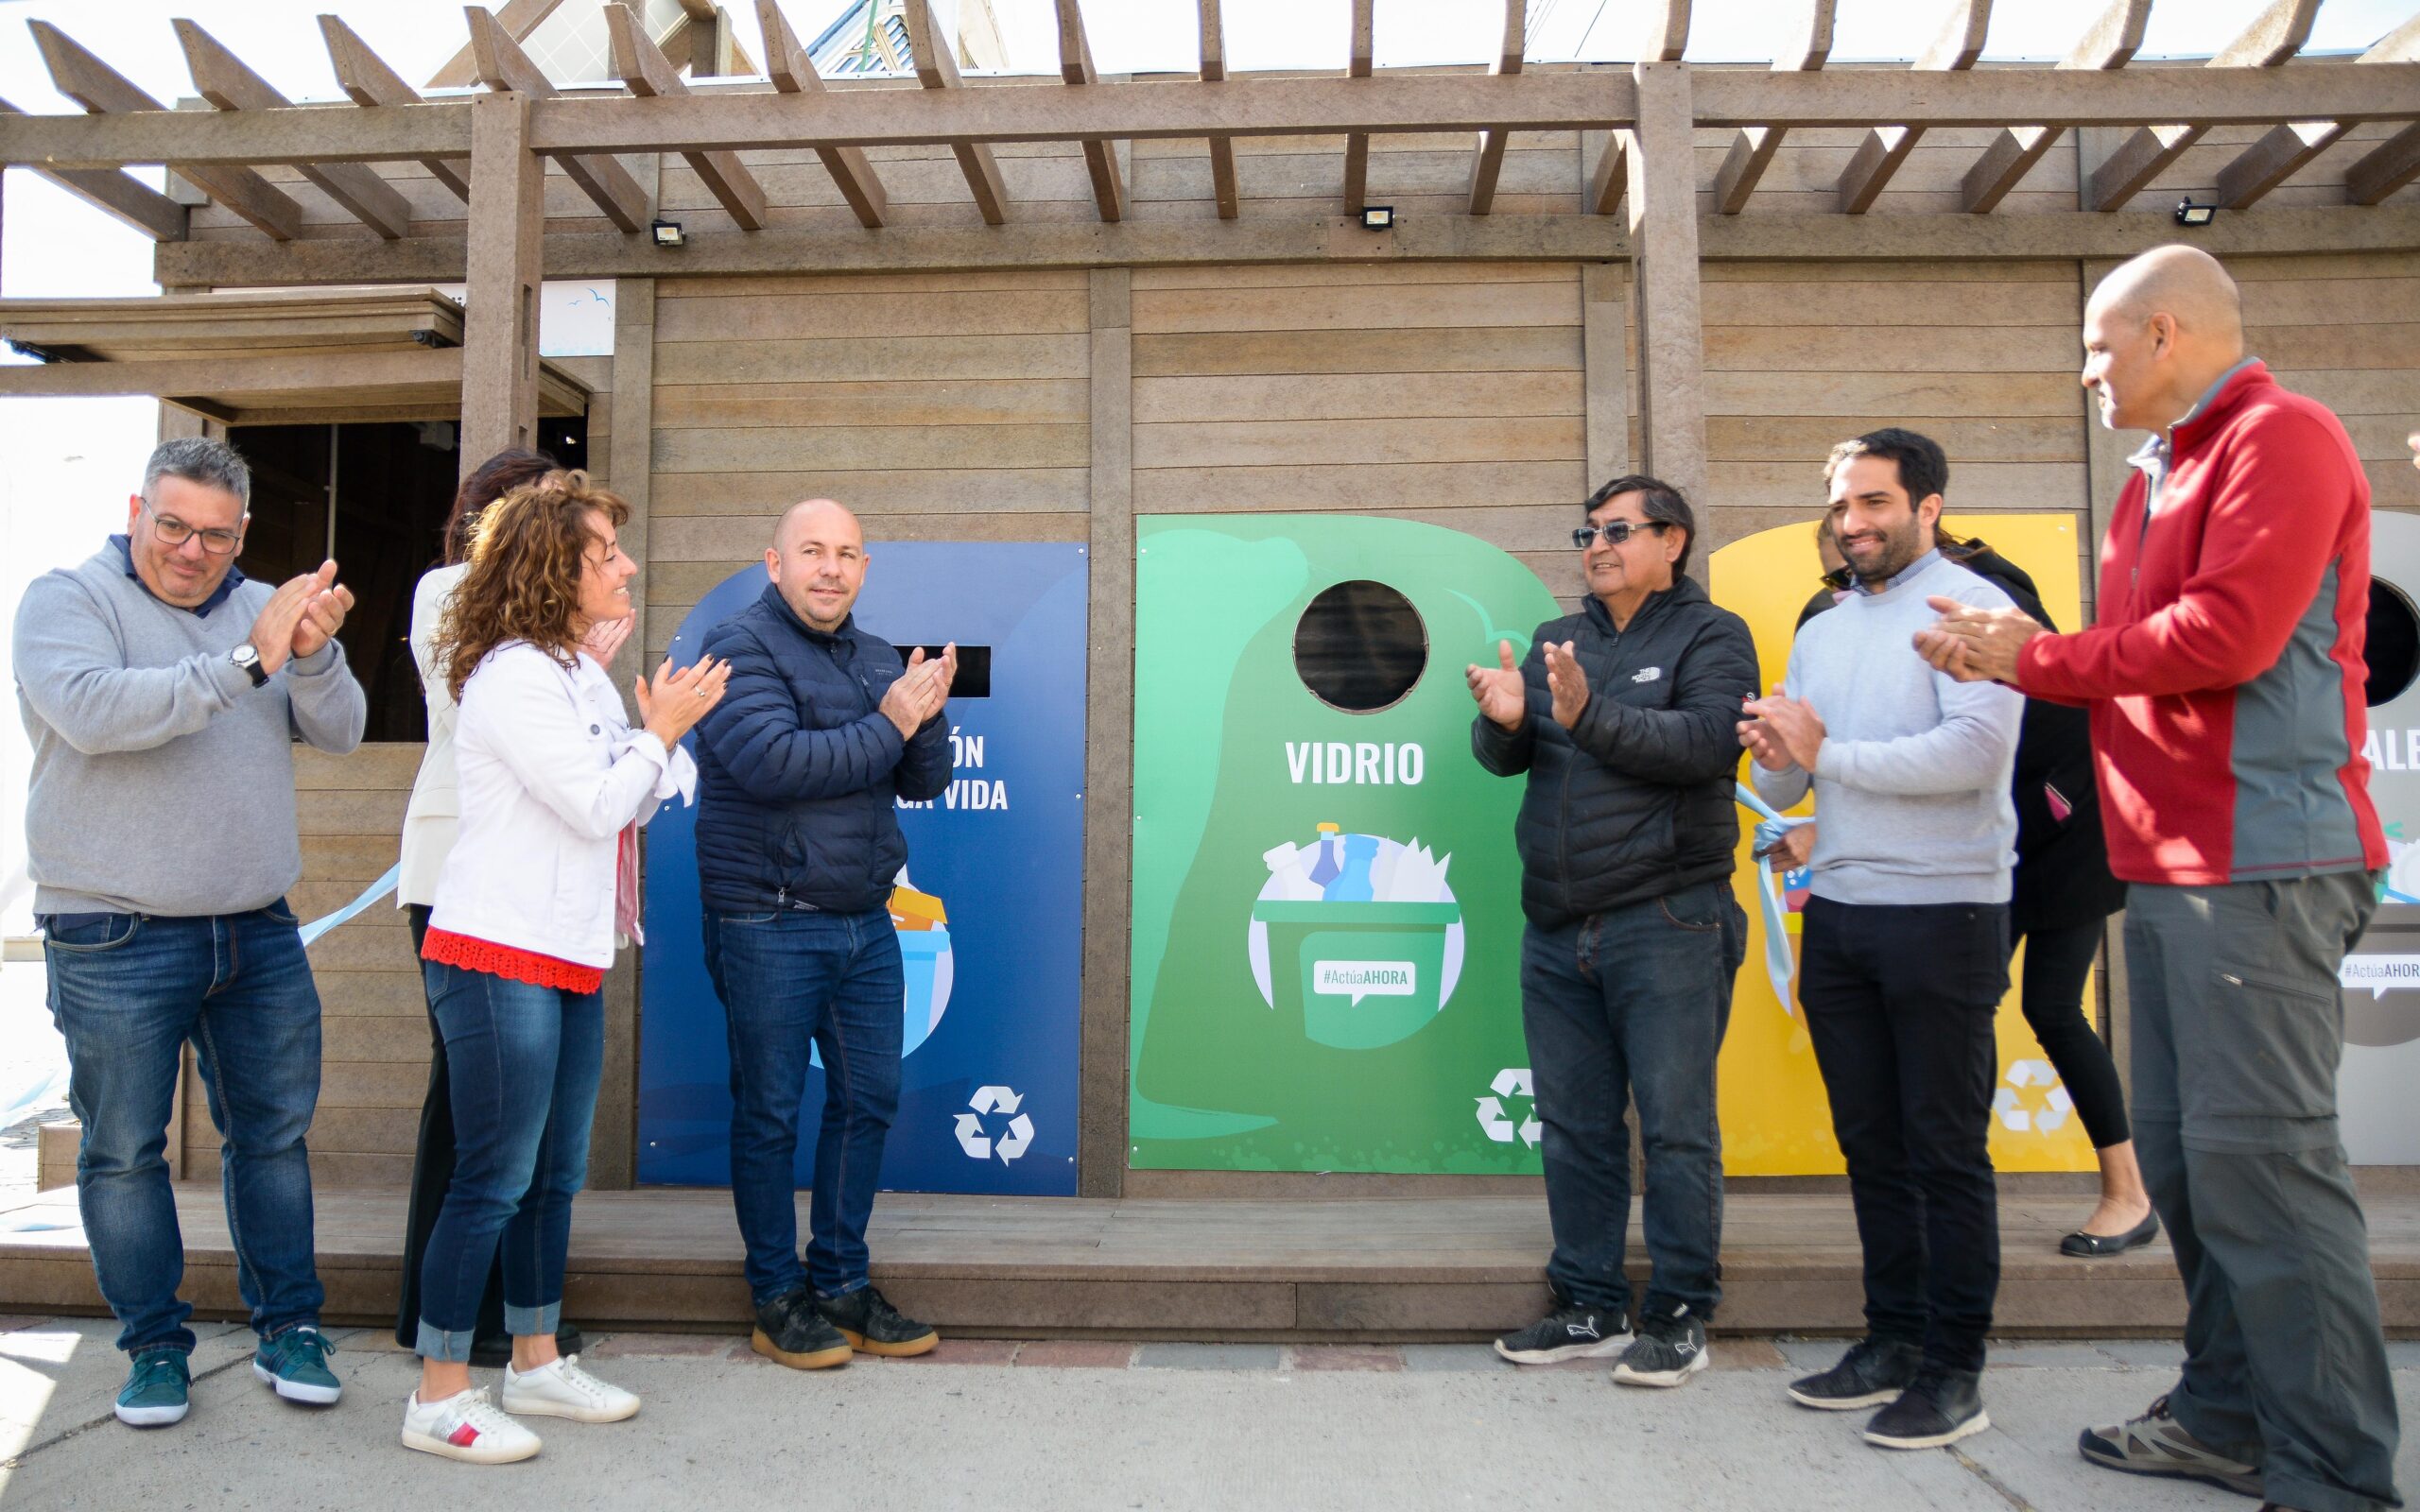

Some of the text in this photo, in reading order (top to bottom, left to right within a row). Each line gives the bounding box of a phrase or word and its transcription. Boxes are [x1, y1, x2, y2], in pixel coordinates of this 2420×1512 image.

[1285, 741, 1424, 785] VIDRIO
[944, 780, 1009, 810] VIDA
[1323, 969, 1408, 985] #ActúaAHORA
